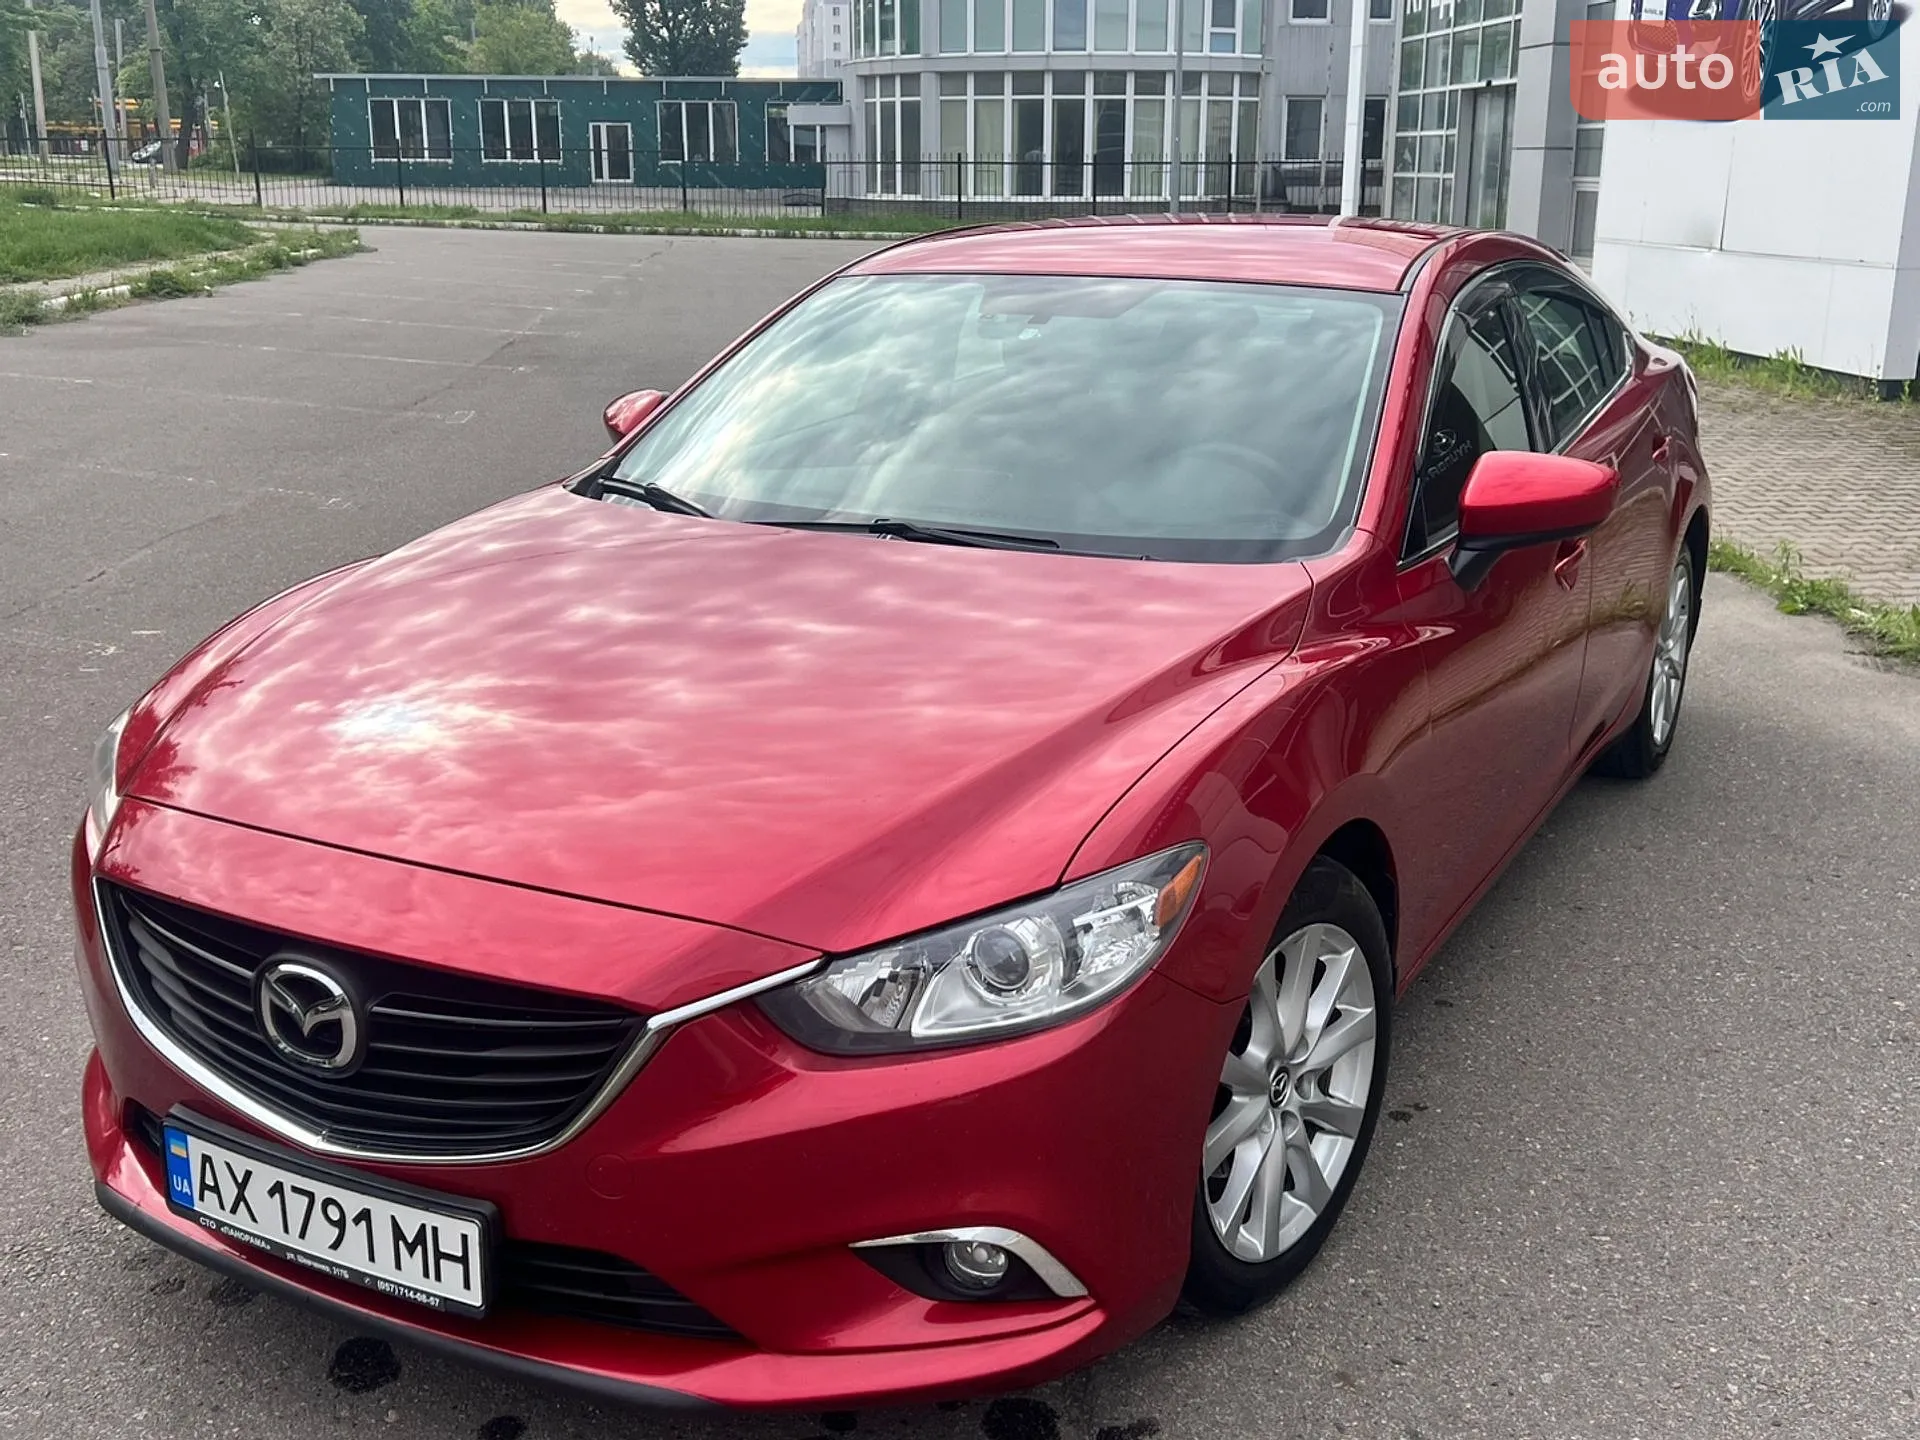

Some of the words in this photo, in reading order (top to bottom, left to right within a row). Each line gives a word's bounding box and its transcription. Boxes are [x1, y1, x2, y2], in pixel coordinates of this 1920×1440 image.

[173, 1174, 191, 1196] UA
[198, 1152, 258, 1224] AX
[266, 1180, 376, 1263] 1791
[391, 1214, 471, 1291] MH
